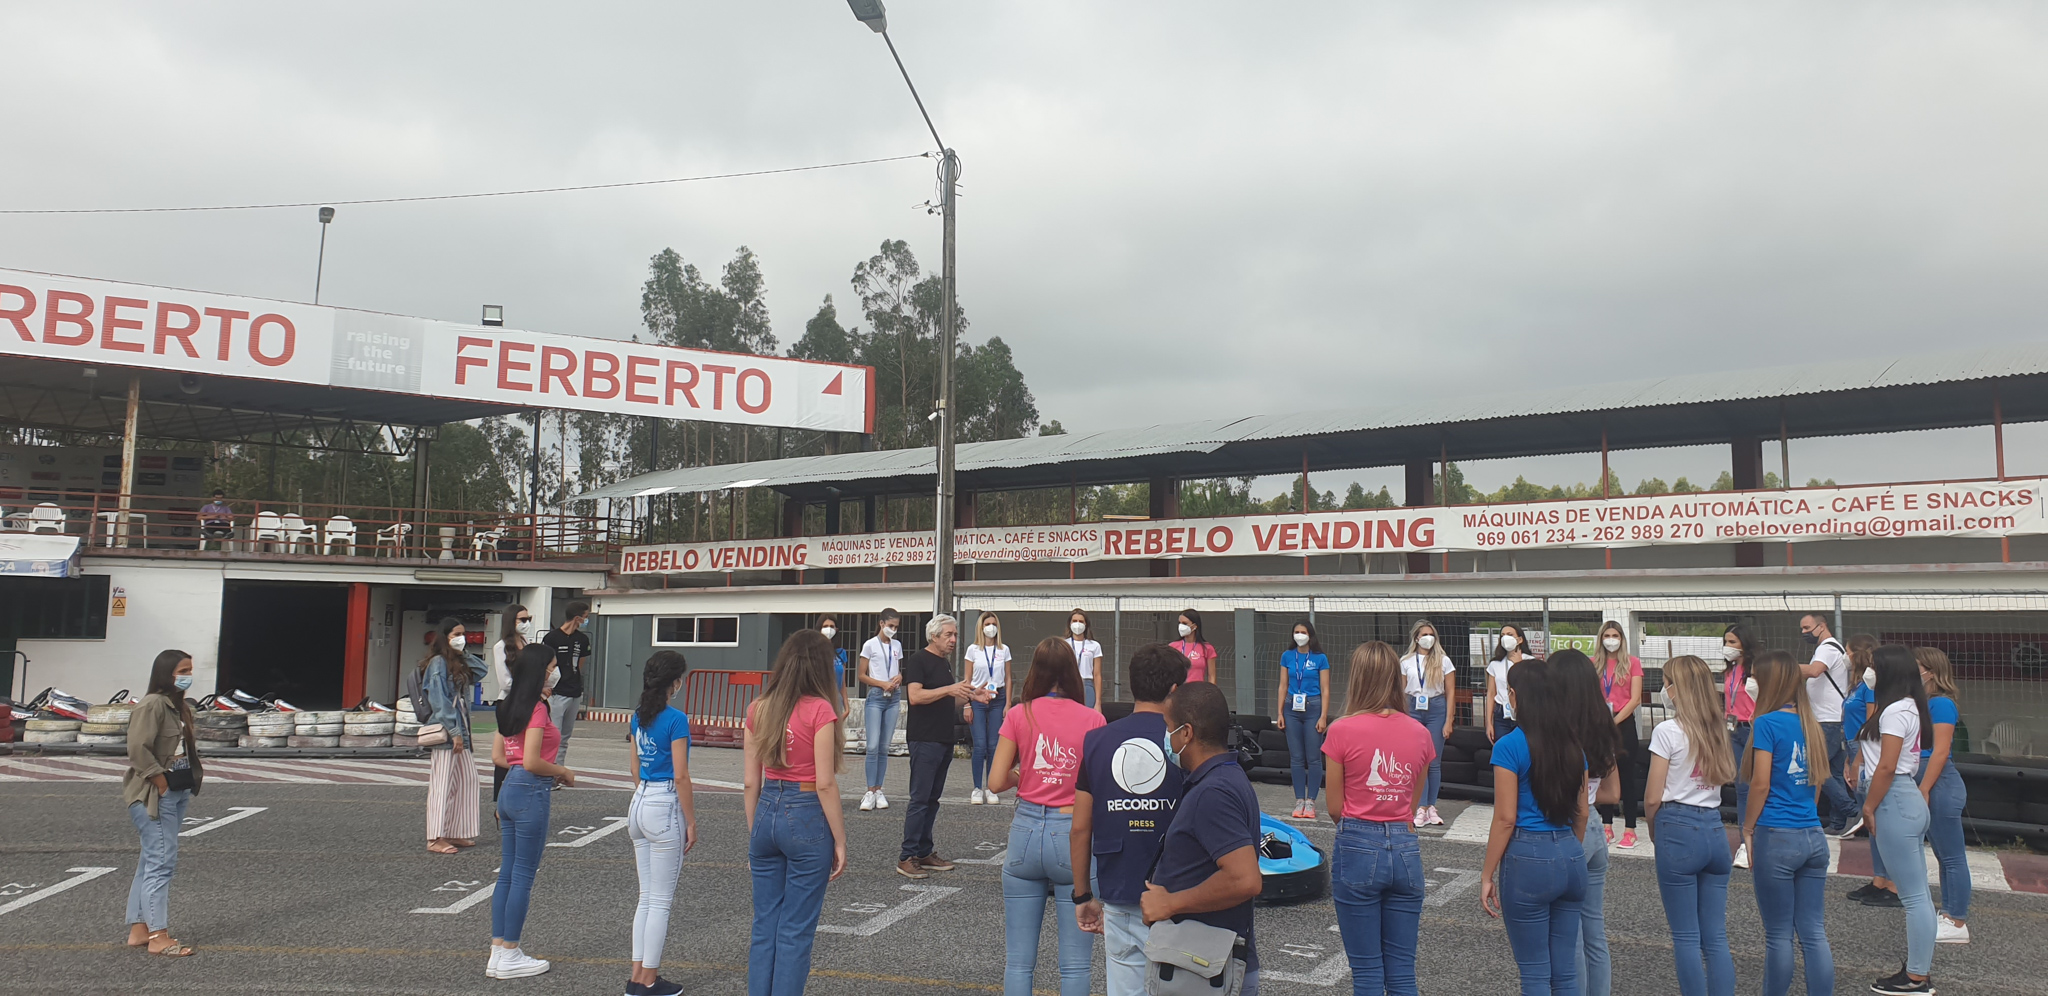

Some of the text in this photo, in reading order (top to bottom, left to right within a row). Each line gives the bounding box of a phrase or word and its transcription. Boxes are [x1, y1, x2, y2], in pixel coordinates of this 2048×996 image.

[347, 330, 410, 350] raising
[363, 345, 393, 359] the
[347, 357, 406, 375] future
[455, 336, 771, 414] FERBERTO
[1463, 509, 1559, 528] MÁQUINAS
[1566, 508, 1590, 523] DE
[1595, 505, 1664, 522] VENDA
[1669, 496, 1811, 518] AUTOMÁTICA
[1831, 491, 1895, 512] CAFÉ
[1904, 493, 1918, 510] E
[1927, 489, 2033, 509] SNACKS
[1104, 518, 1435, 555] REBELO VENDING
[1477, 531, 1506, 546] 969
[1511, 530, 1539, 545] 061
[1546, 528, 1576, 543] 234
[1593, 526, 1625, 541] 262
[1631, 525, 1664, 539] 989
[1670, 523, 1704, 538] 270
[1716, 514, 2015, 537] rebelovending@gmail.com
[822, 538, 871, 552] MÁQUINAS
[873, 538, 886, 549] DE
[889, 536, 925, 549] VENDA
[1005, 529, 1035, 544] CAFÉ
[1037, 532, 1045, 543] E
[1048, 529, 1098, 542] SNACKS
[623, 543, 807, 572] REBELO VENDING
[828, 553, 843, 565] 969
[845, 553, 861, 564] 061
[864, 552, 879, 563] 234
[886, 551, 904, 563] 262
[907, 551, 923, 562] 989
[953, 546, 1089, 562] ebelovending@gmail.com
[1042, 776, 1063, 785] 2021
[1107, 798, 1177, 812] RECORDTV
[1129, 820, 1155, 828] PRESS
